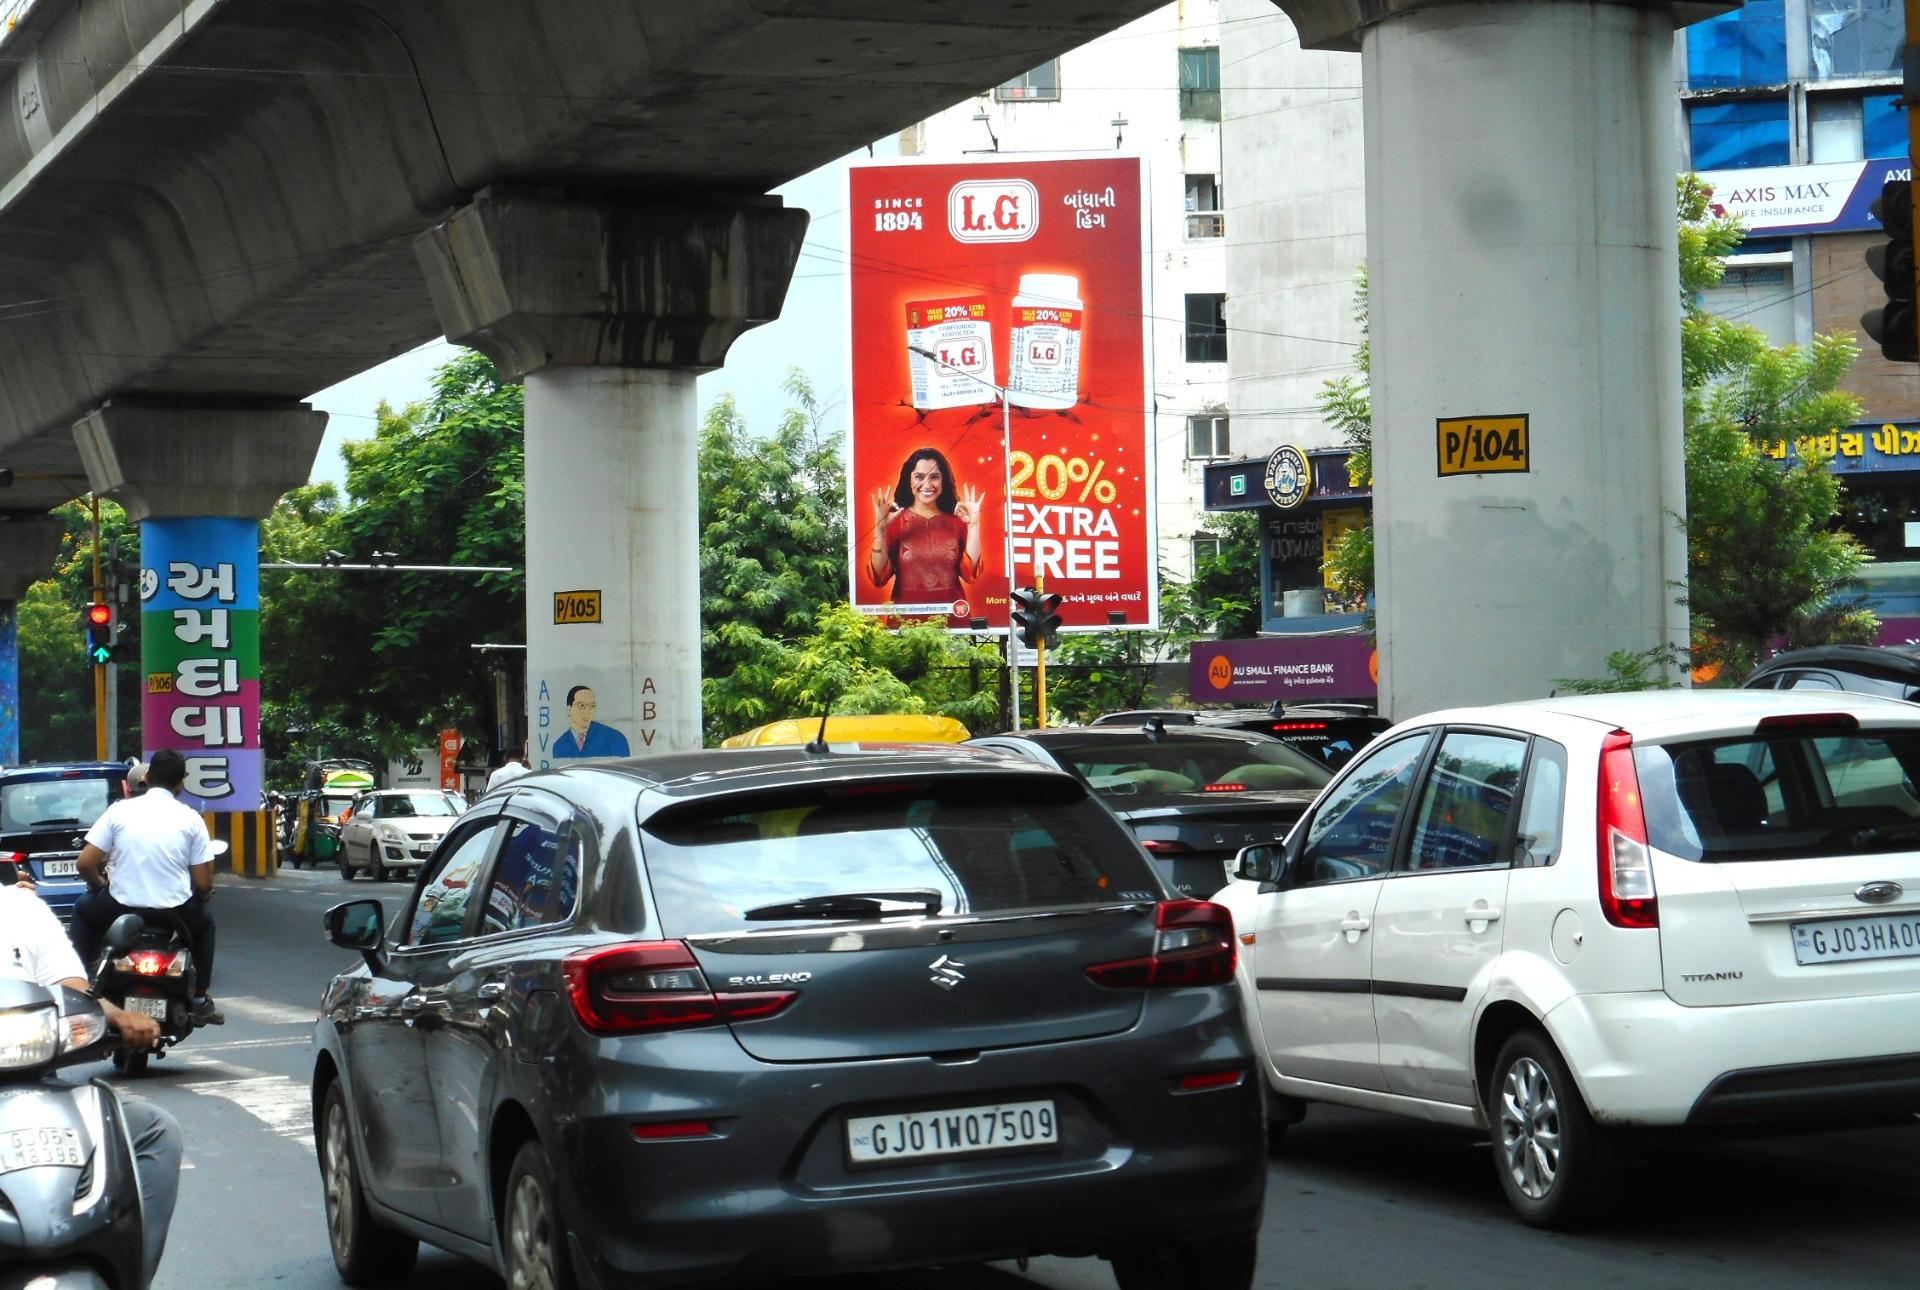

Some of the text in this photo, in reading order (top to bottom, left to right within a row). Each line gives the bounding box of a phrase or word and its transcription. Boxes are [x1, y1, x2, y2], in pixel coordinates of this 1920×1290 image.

[874, 198, 923, 208] SINCE
[1729, 182, 1831, 204] AXIS MAX
[961, 194, 1026, 232] L.G.
[1076, 208, 1106, 229] હિંગ
[1760, 204, 1825, 216] INSURANCE
[874, 211, 923, 231] 1894
[944, 305, 968, 318] 20%
[1036, 309, 1059, 321] 20%
[1032, 347, 1057, 360] L.G.
[1446, 425, 1524, 468] P/104
[1004, 450, 1117, 504] 20%
[1004, 502, 1119, 537] EXTRA
[1004, 537, 1120, 579] FREE
[556, 596, 596, 620] P/105
[1211, 664, 1334, 679] AU AU SMALL FINANCE BANK
[11, 1129, 62, 1148] GJ05
[872, 1108, 1053, 1154] GJ01WQ7509
